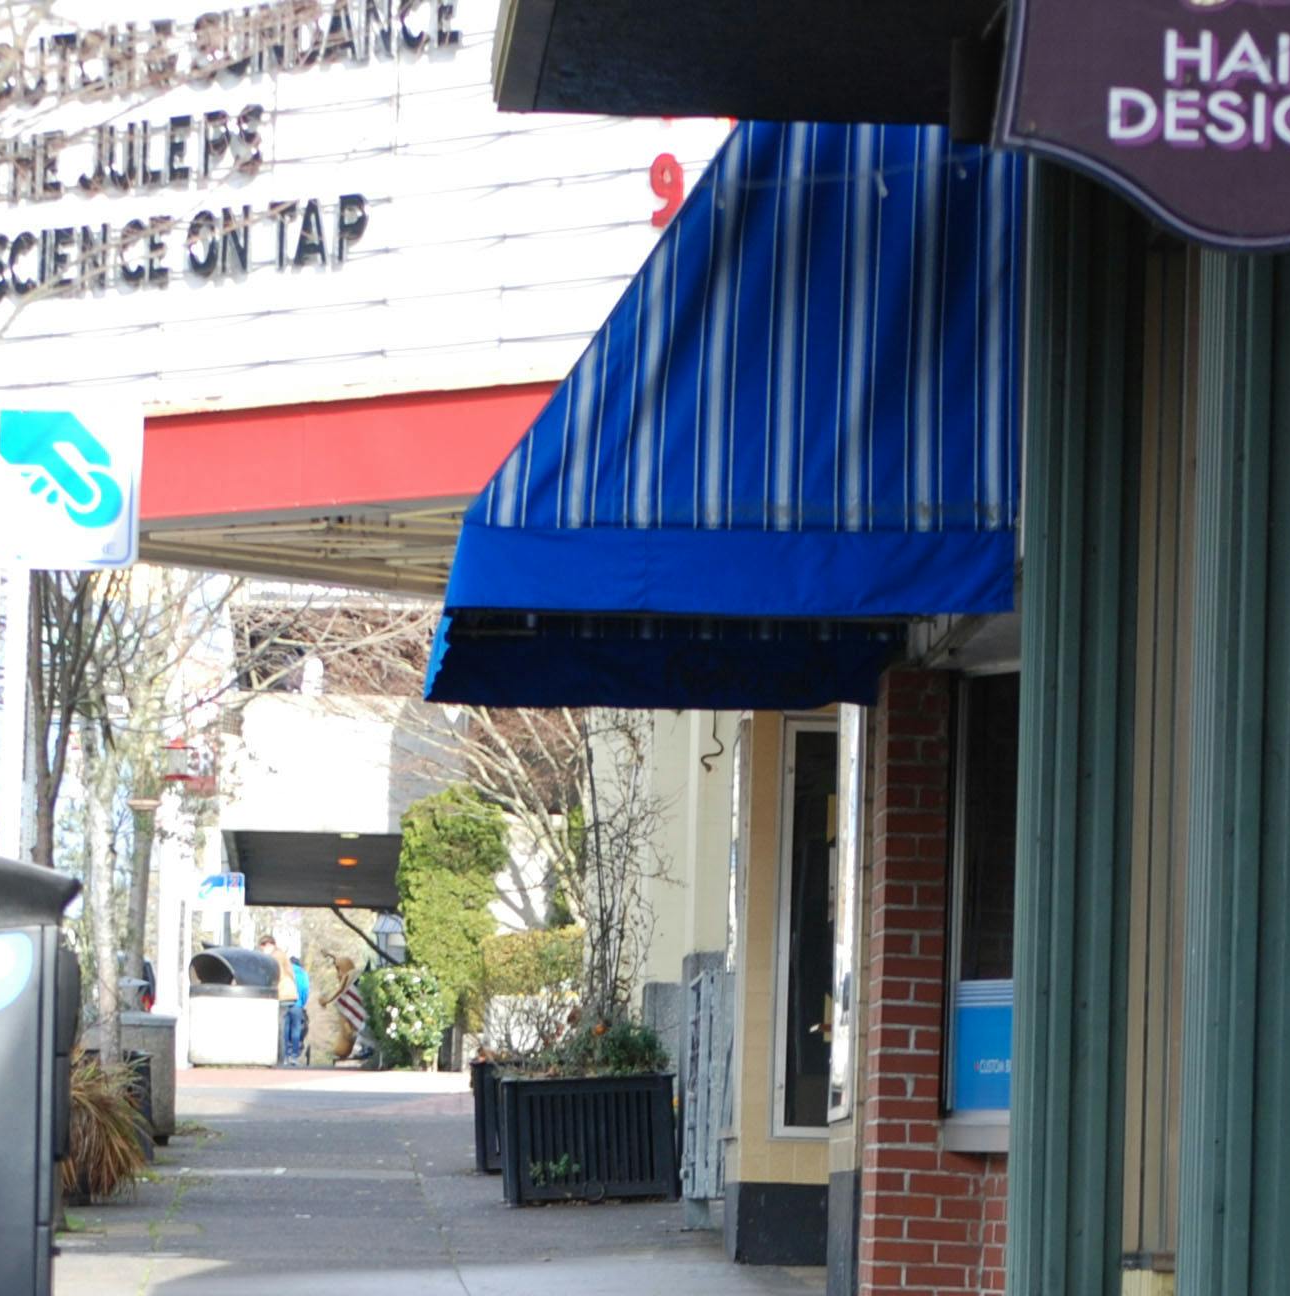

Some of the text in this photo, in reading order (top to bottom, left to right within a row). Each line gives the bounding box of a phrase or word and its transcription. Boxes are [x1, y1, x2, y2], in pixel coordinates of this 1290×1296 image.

[78, 103, 265, 191] JULEPS
[650, 153, 683, 228] 9
[187, 204, 252, 277] ON
[268, 193, 369, 271] TAP
